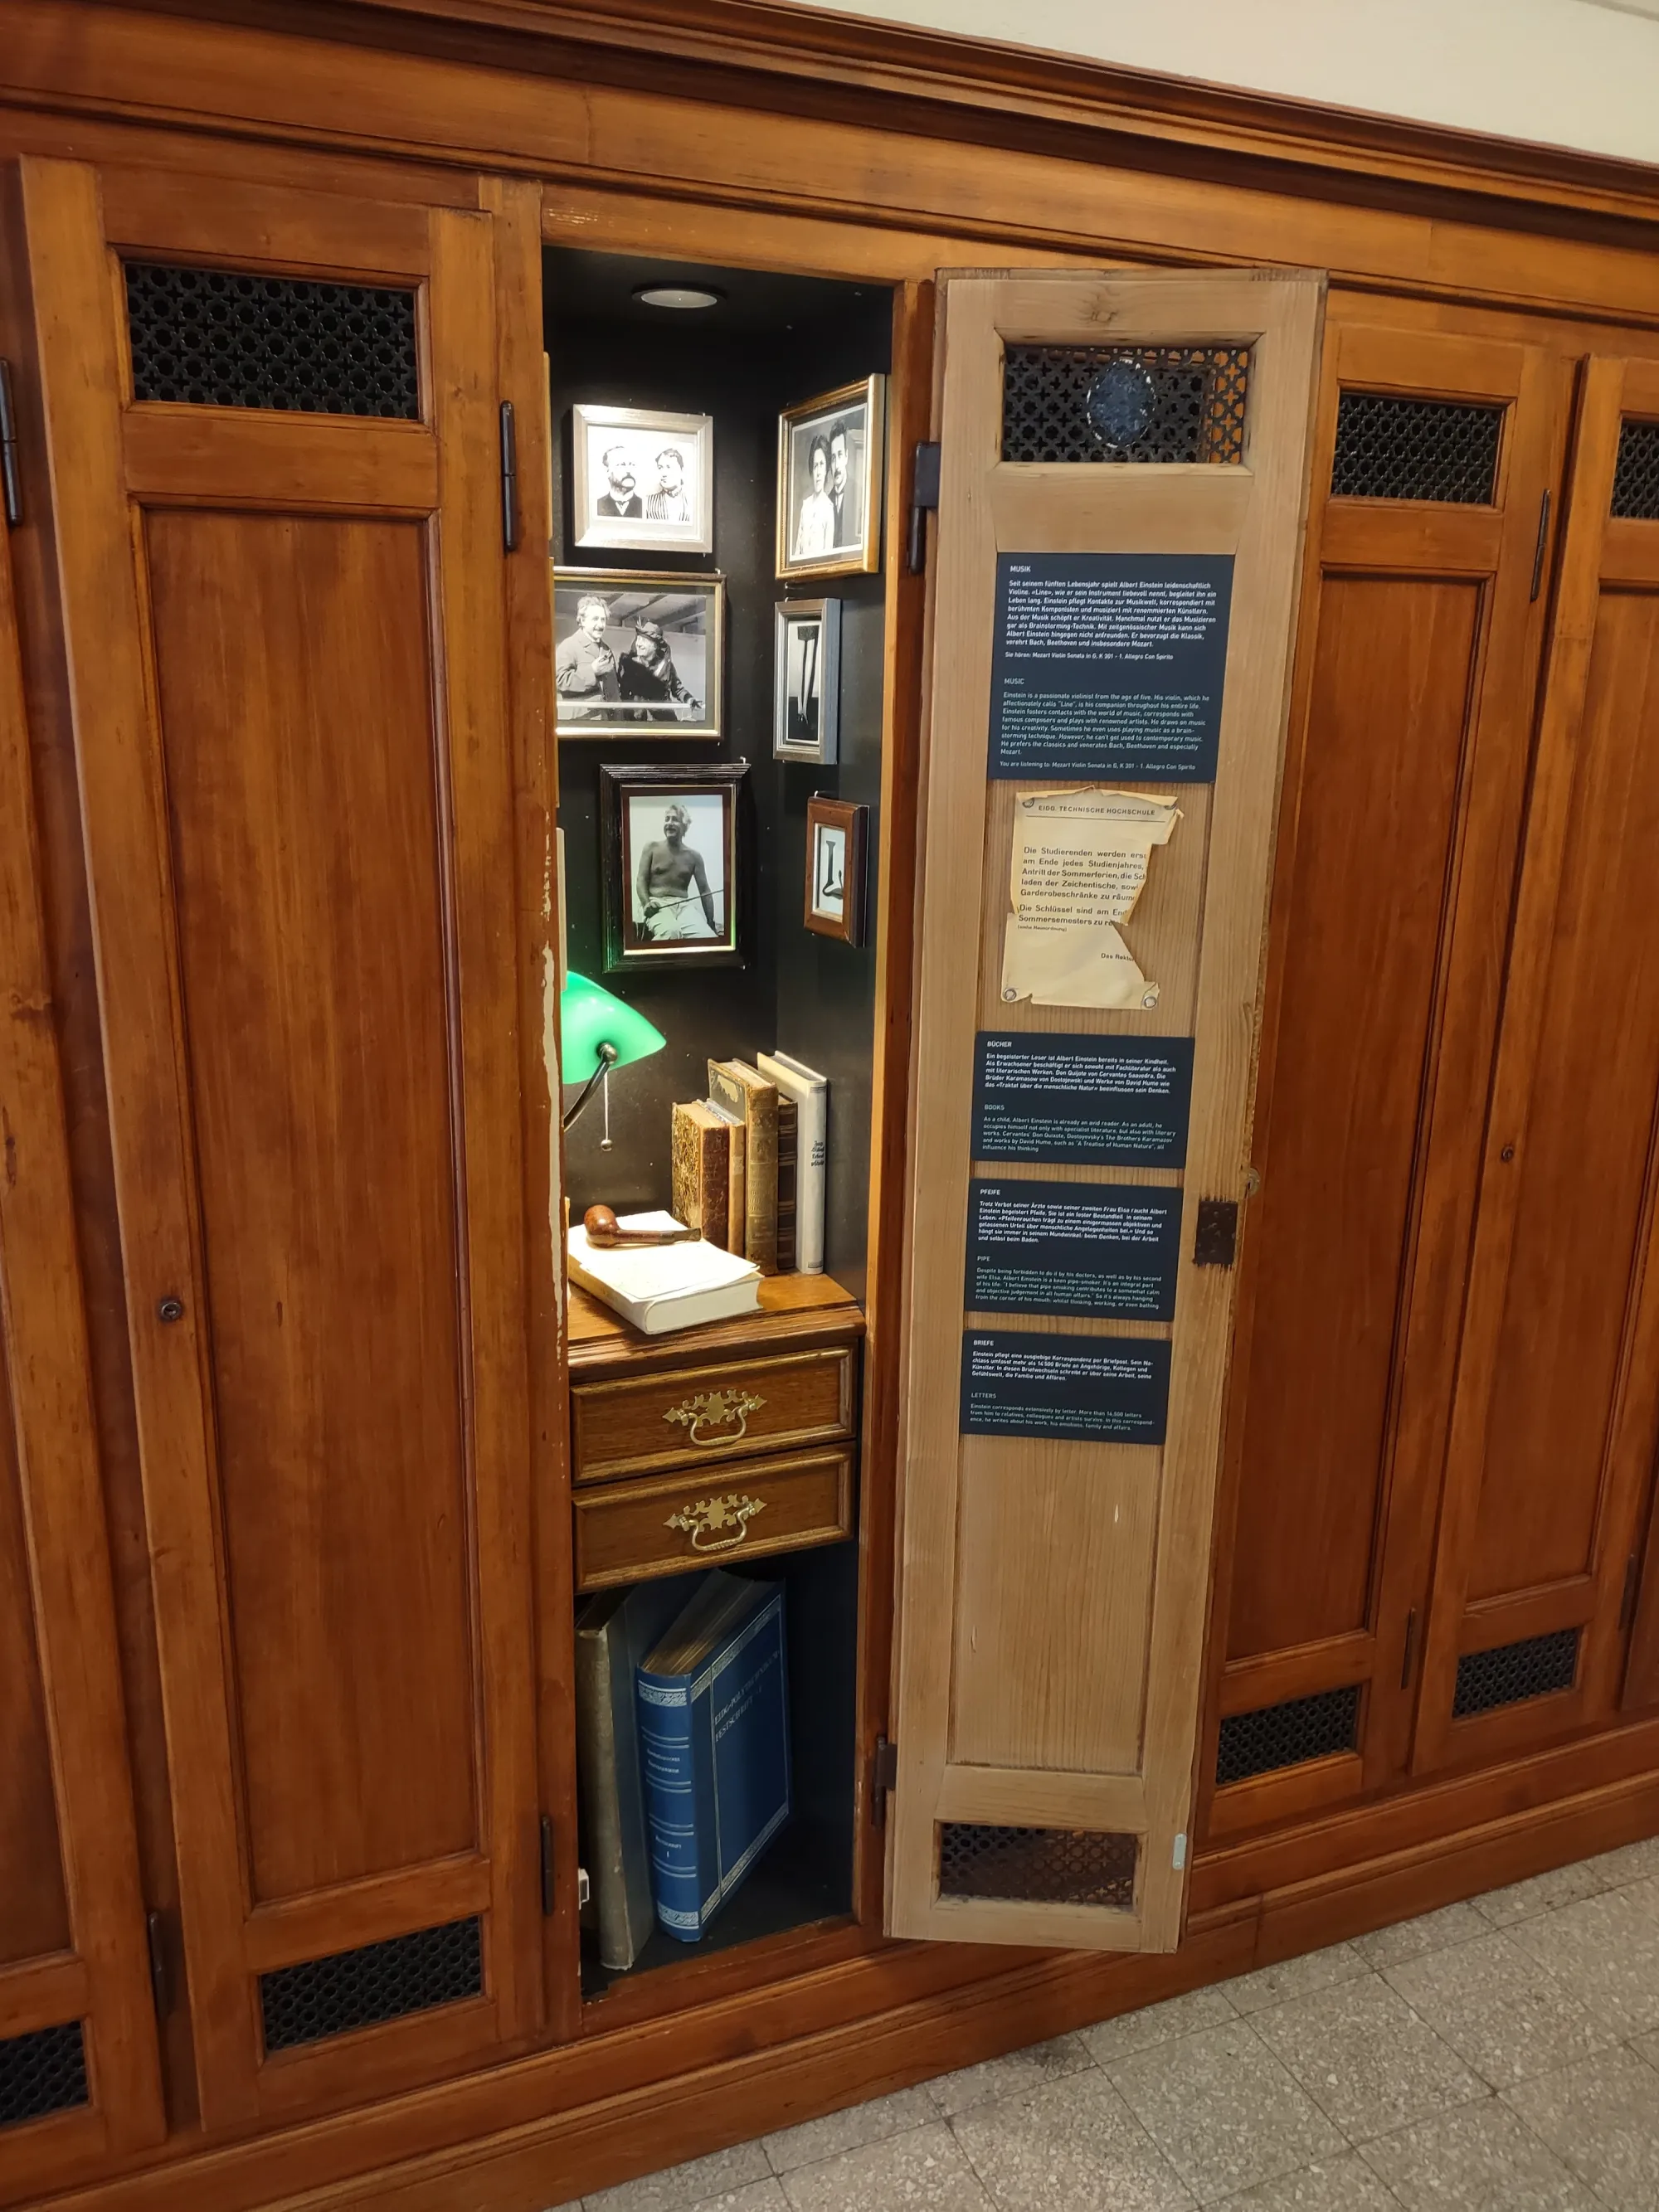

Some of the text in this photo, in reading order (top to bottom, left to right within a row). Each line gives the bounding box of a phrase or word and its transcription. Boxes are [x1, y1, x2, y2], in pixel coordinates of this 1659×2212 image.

[1041, 848, 1092, 856] Studierenden
[1088, 860, 1144, 869] Studienjahres,
[1062, 870, 1120, 879] Sommerferien,
[1062, 880, 1117, 890] Zeichentische,
[1020, 889, 1097, 899] Garderobeschränke
[1035, 905, 1072, 913] Schlüssel
[1019, 915, 1092, 925] Sommersemesters
